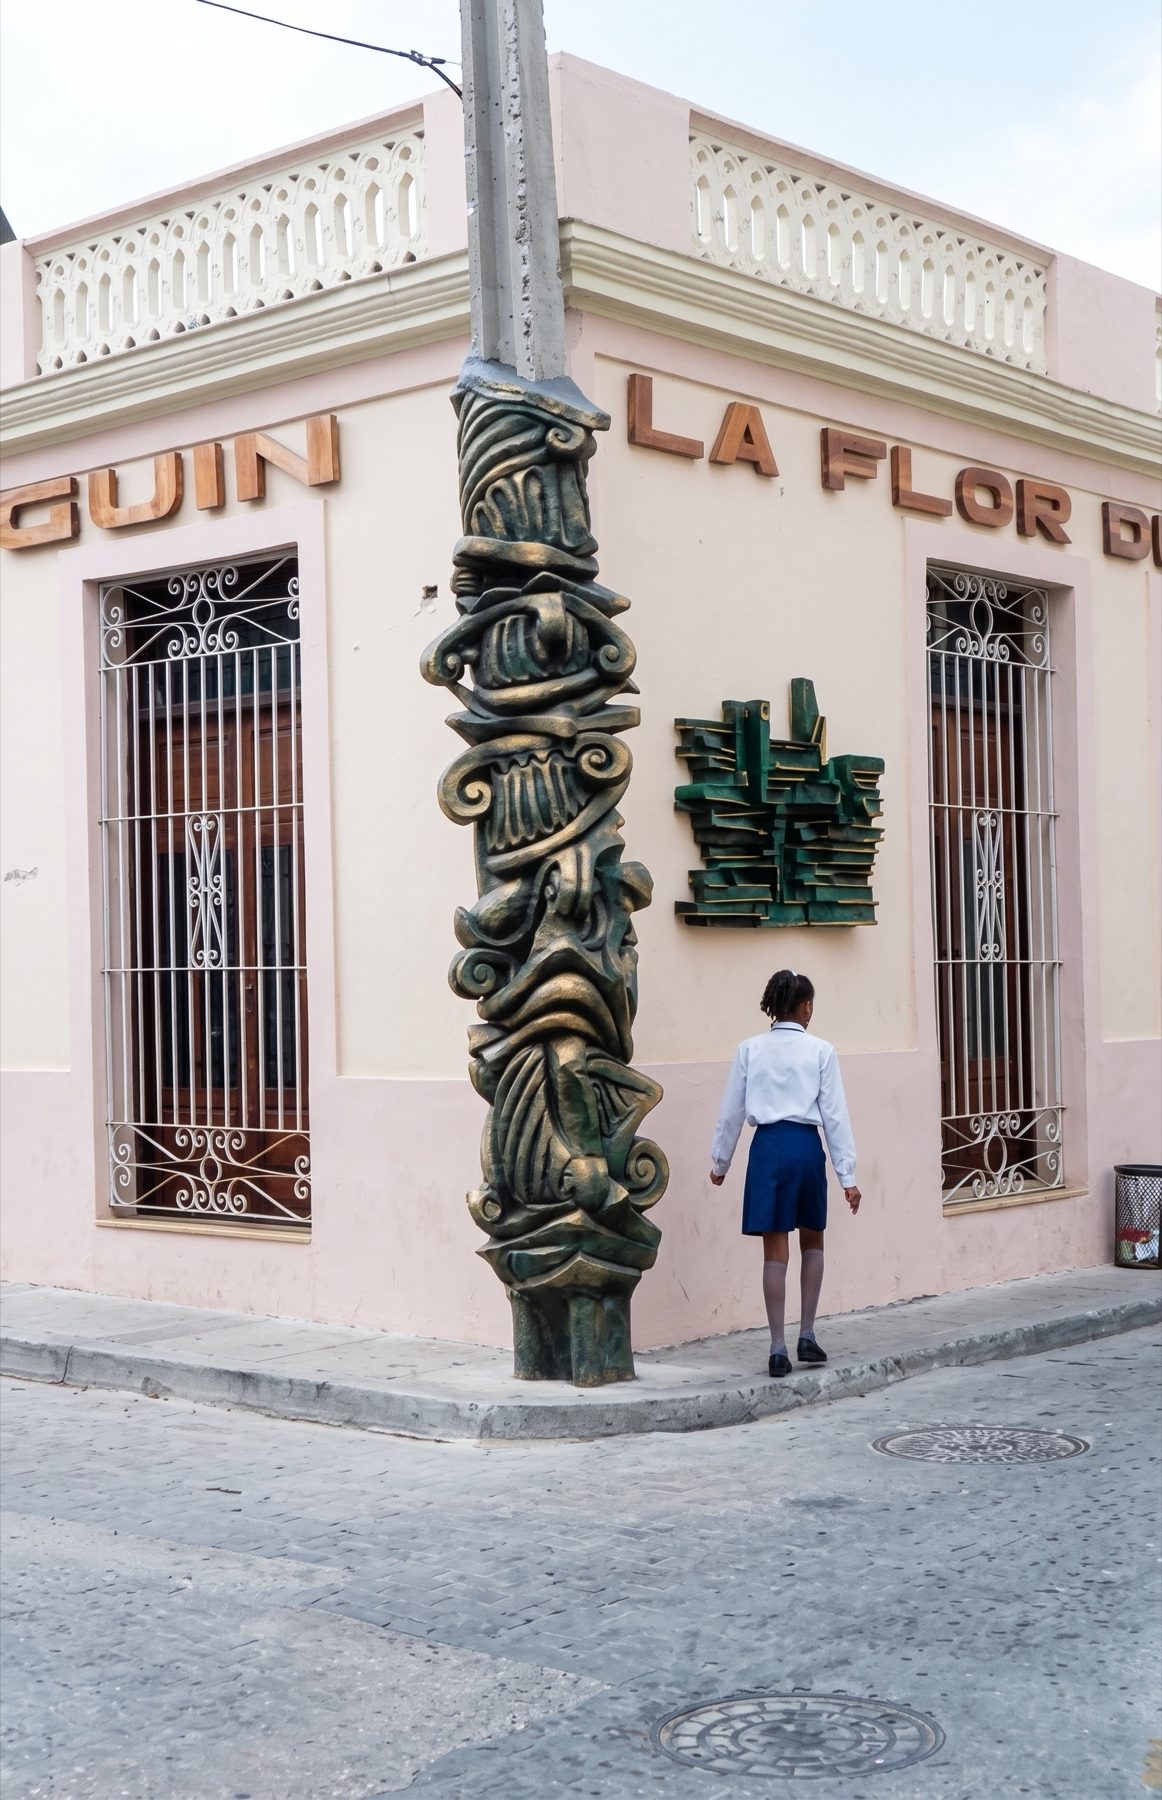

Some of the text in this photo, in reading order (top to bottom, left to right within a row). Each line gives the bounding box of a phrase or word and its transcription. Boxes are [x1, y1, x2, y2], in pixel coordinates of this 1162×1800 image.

[0, 414, 340, 551] GUIN
[627, 372, 1162, 567] LA FLOR D
